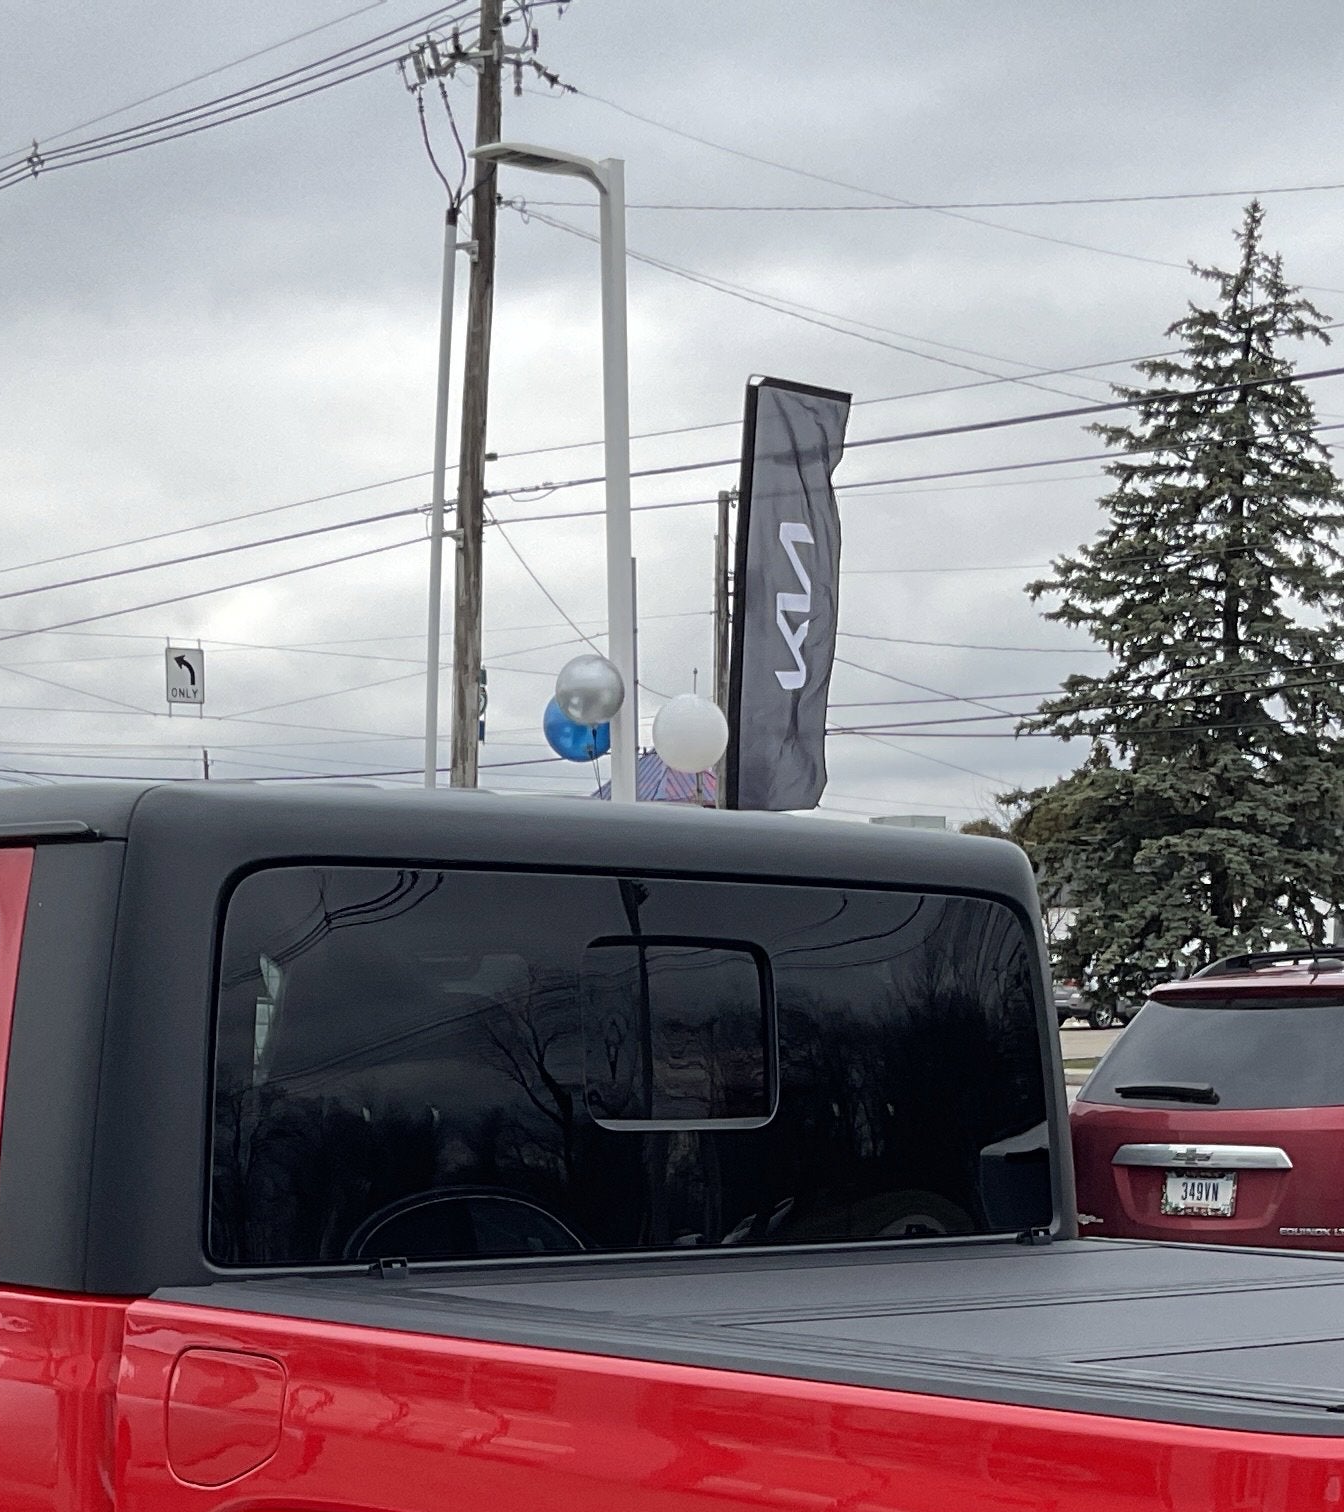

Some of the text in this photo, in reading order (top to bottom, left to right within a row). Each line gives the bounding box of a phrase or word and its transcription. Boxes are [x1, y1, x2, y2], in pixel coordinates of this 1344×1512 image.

[171, 687, 198, 699] ONLY
[1181, 1182, 1219, 1202] 349VN
[1279, 1227, 1332, 1236] EQUINOX
